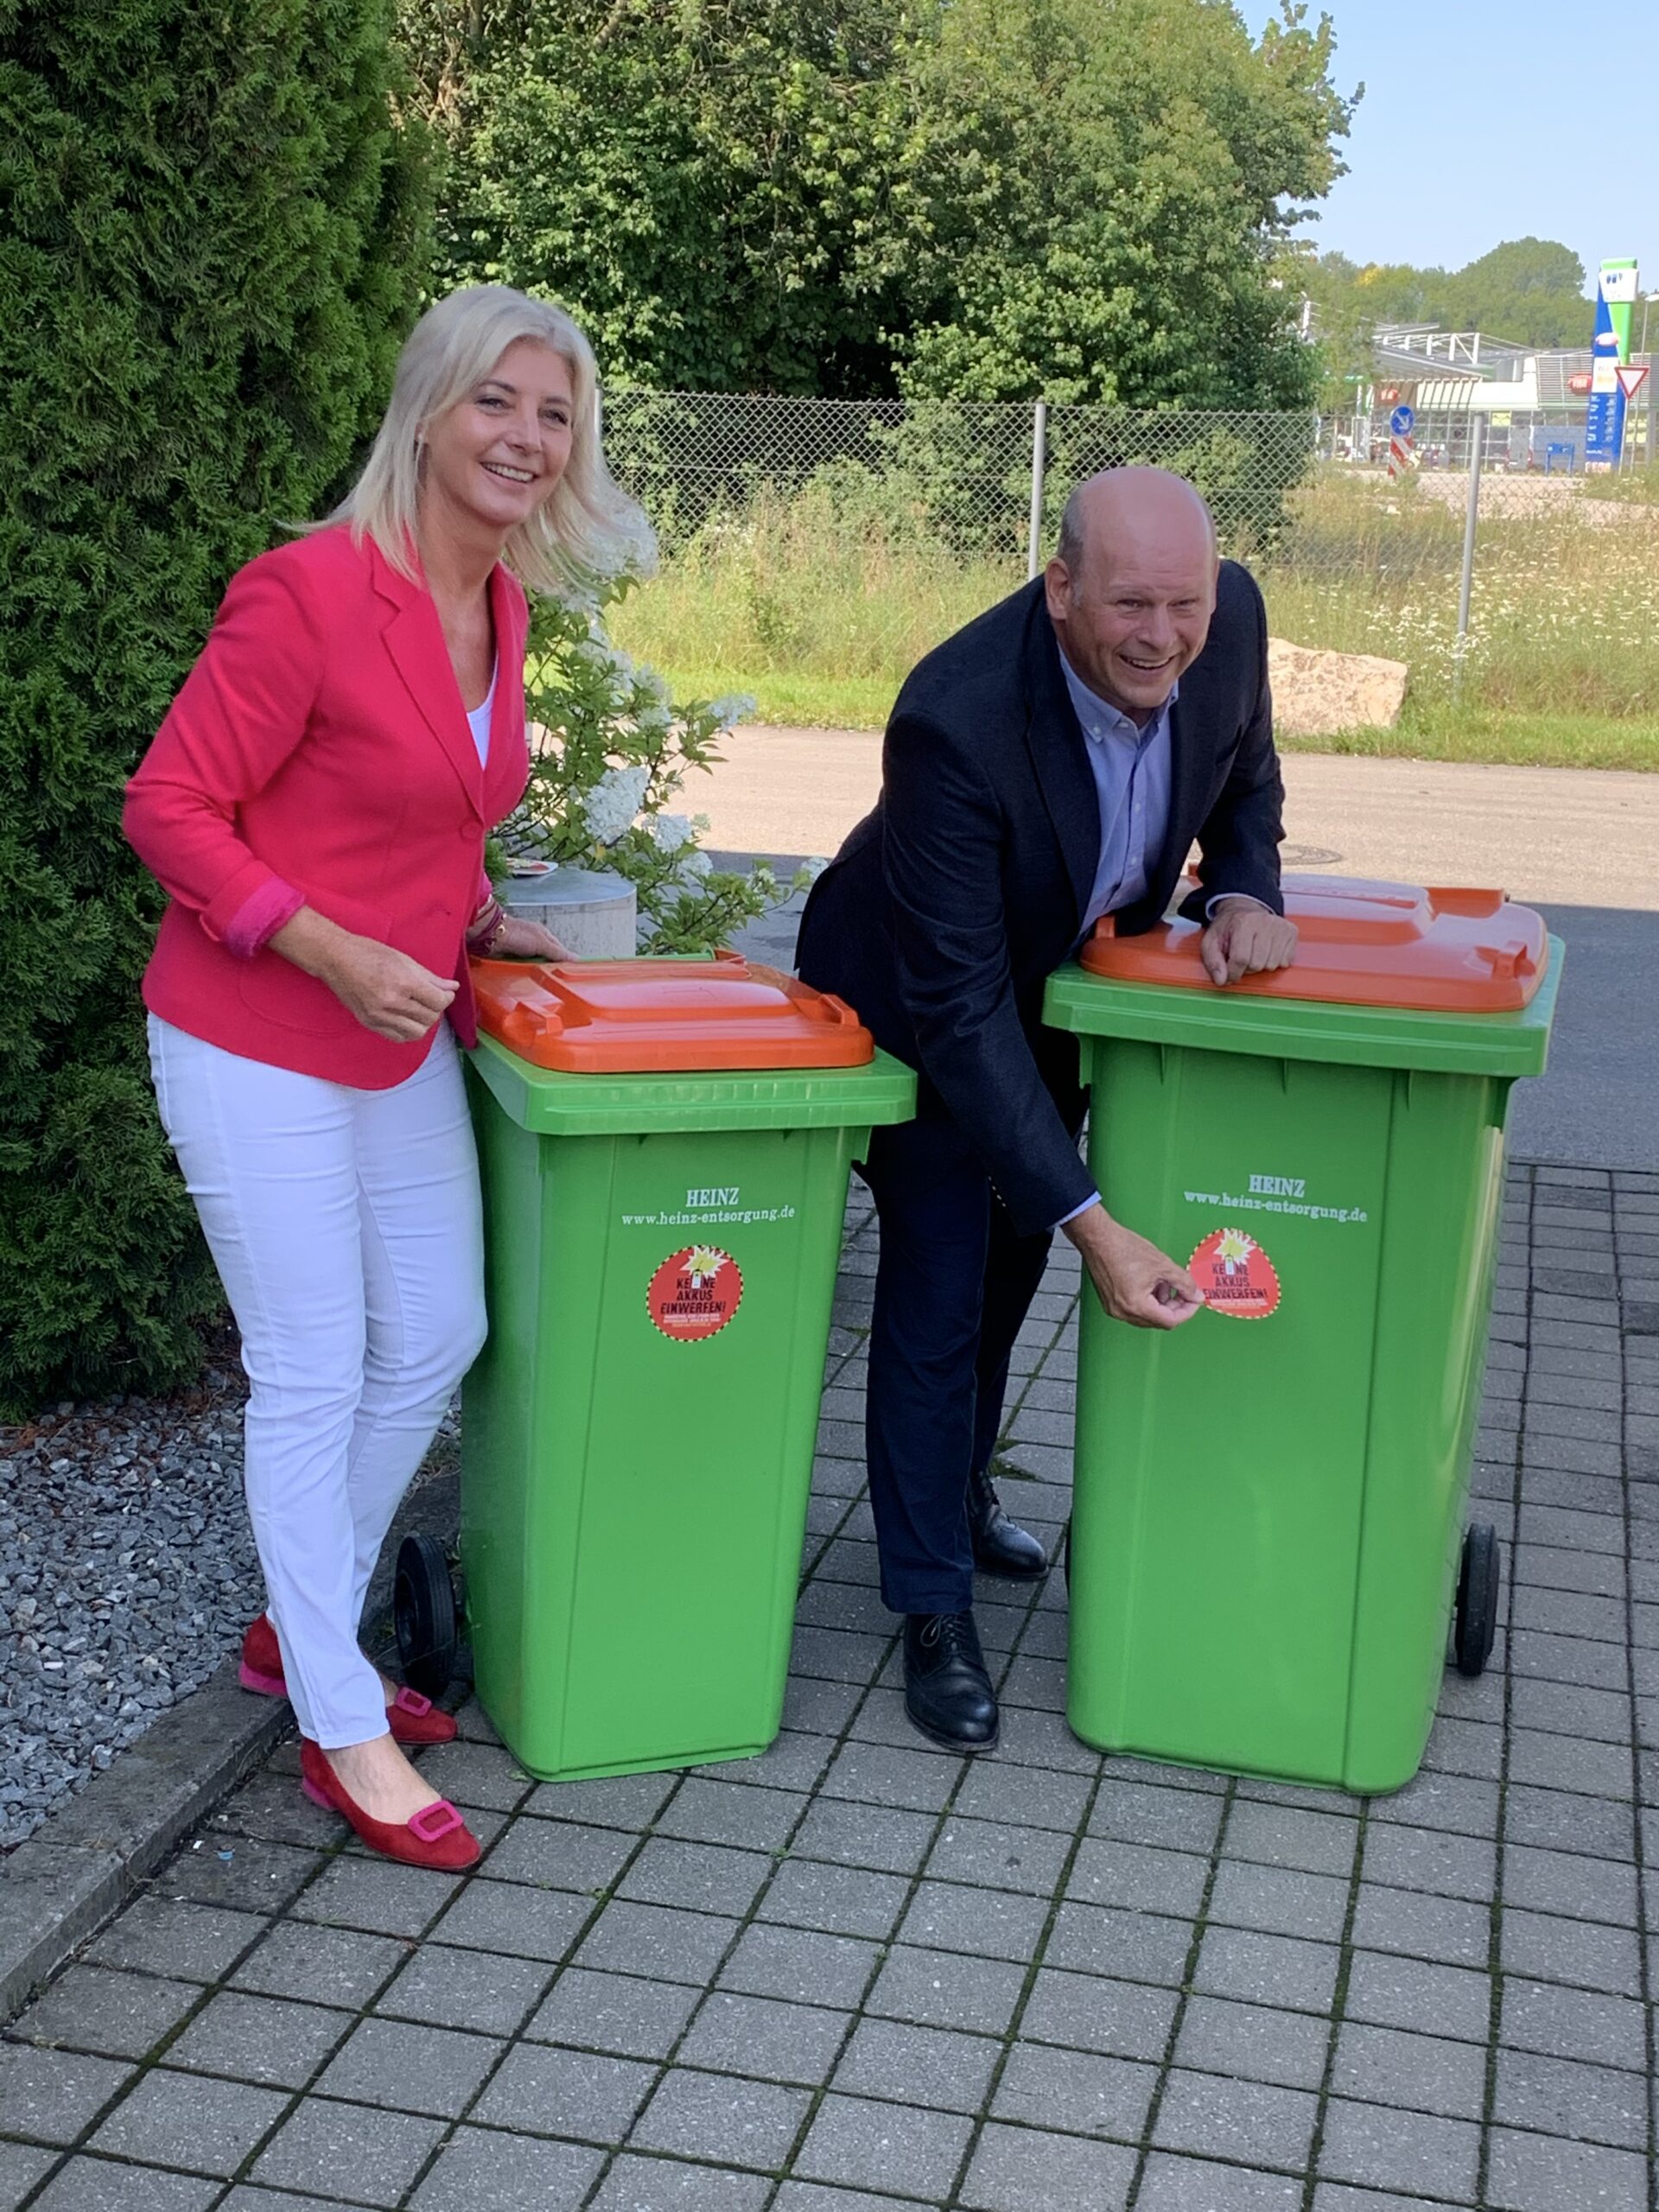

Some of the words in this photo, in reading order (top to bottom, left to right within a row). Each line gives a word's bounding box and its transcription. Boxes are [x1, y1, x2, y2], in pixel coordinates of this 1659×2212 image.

[1249, 1174, 1306, 1198] HEINZ
[685, 1187, 740, 1207] HEINZ
[1184, 1191, 1367, 1223] www.heinz-entsorgung.de
[621, 1205, 795, 1225] www.heinz-entsorgung.de
[1215, 1275, 1251, 1287] AKKUS
[676, 1289, 713, 1301] AKKUS
[660, 1300, 727, 1314] EINWERFEN!
